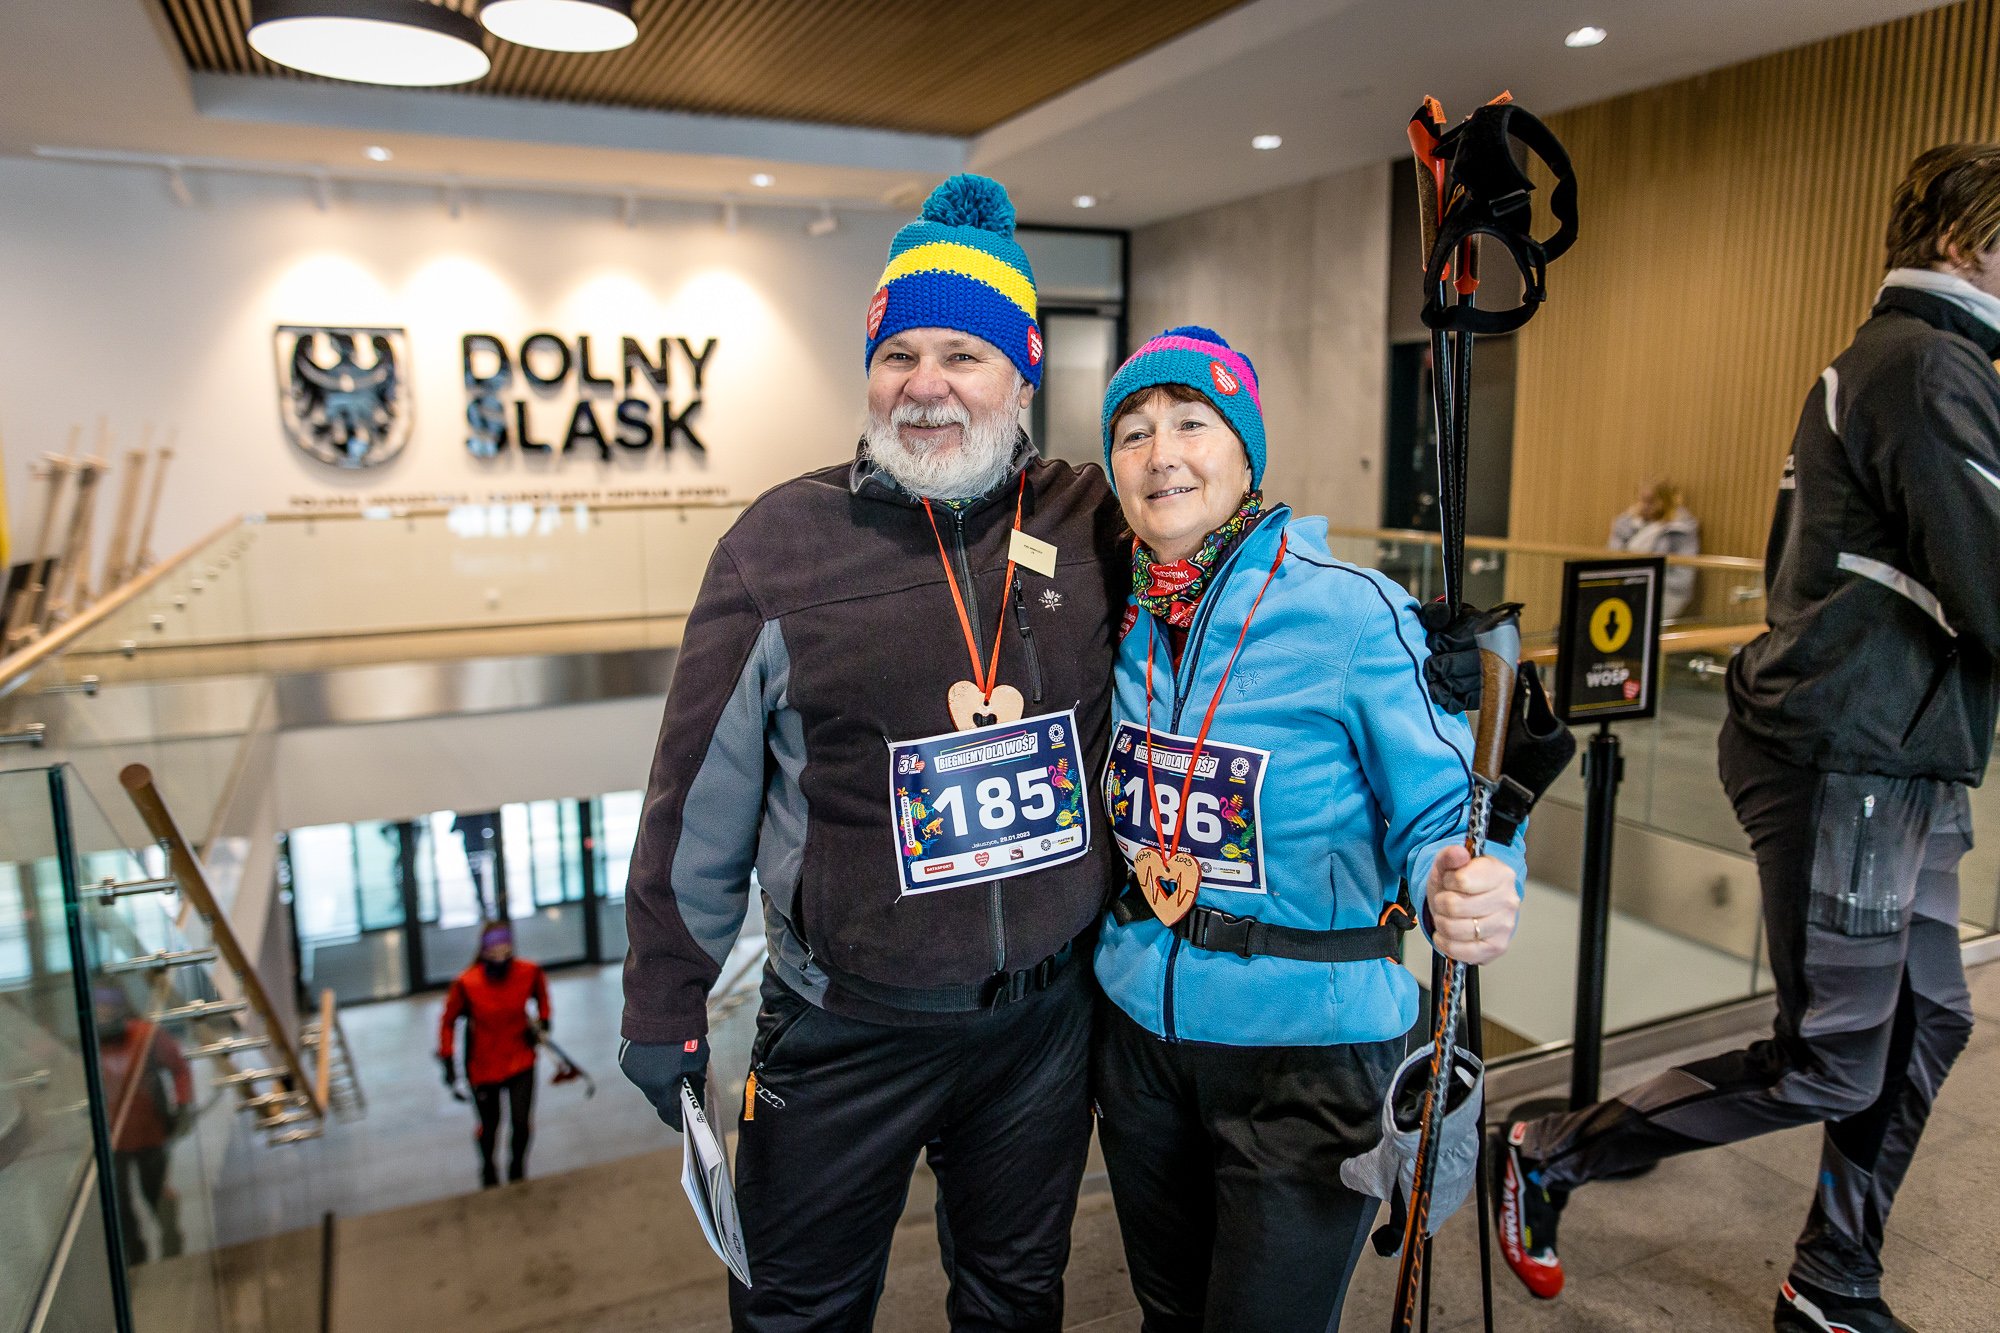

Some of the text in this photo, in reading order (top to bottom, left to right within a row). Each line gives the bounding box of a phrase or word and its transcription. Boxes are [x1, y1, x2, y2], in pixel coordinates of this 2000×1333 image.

[463, 333, 718, 389] DOLNY
[898, 754, 919, 774] 31
[938, 734, 1036, 770] BIEGNIEMY DLA WOŚP
[1165, 754, 1182, 769] DLA
[932, 767, 1055, 837] 185
[1124, 776, 1222, 844] 186
